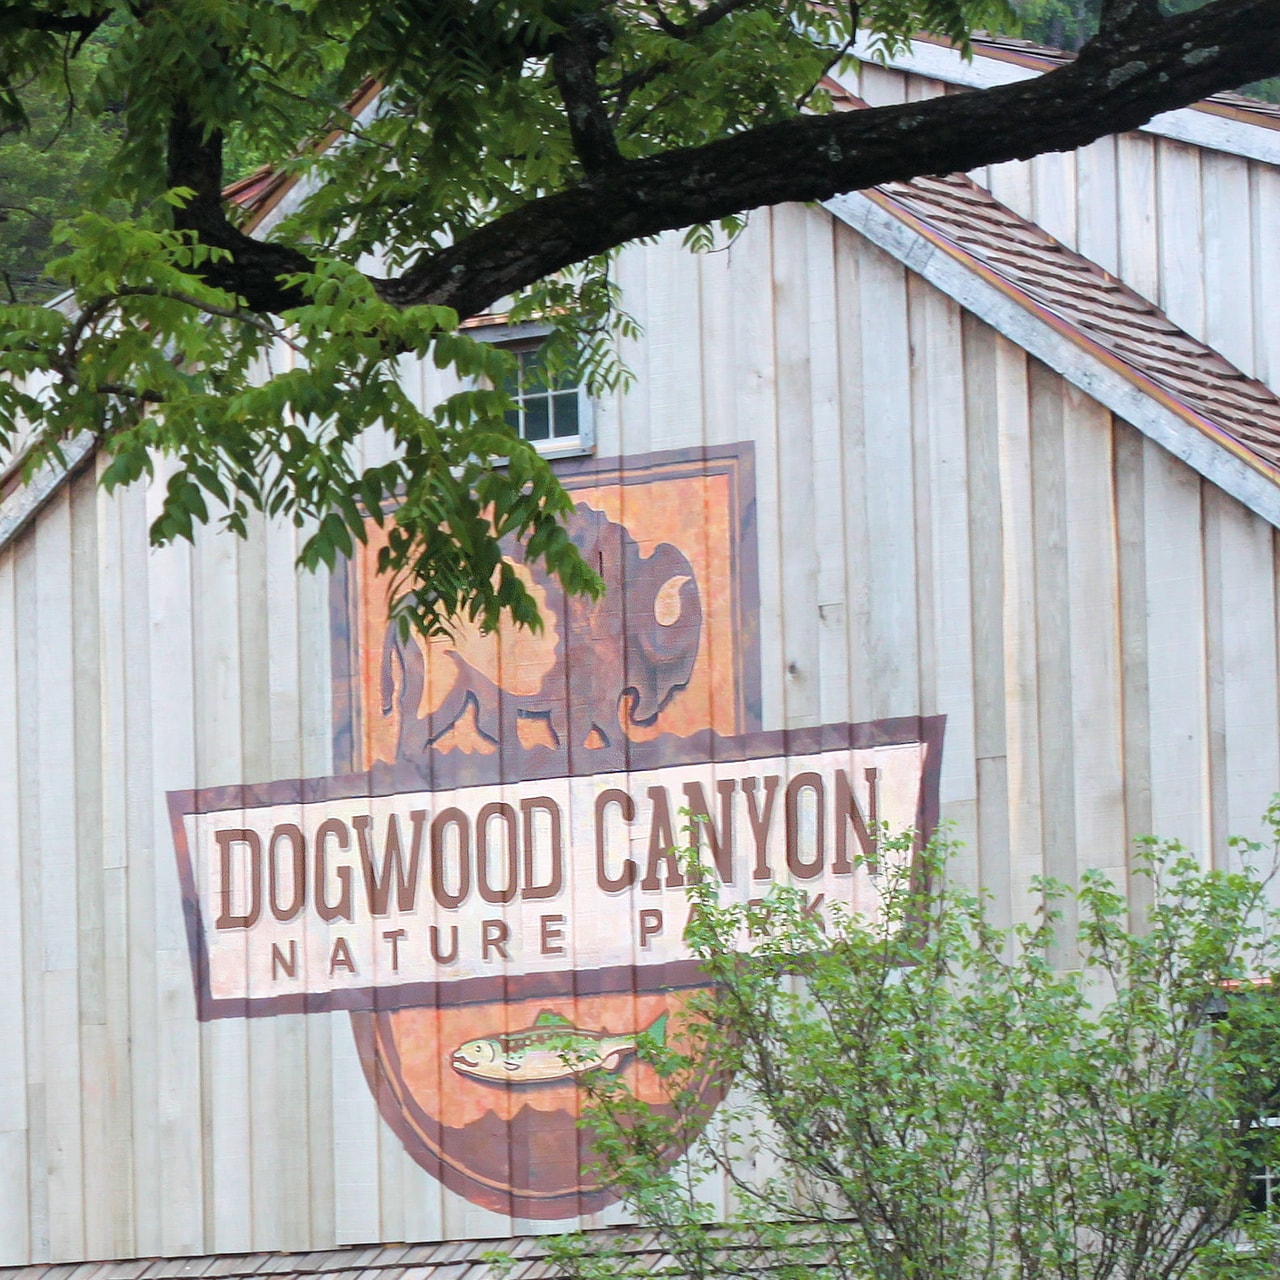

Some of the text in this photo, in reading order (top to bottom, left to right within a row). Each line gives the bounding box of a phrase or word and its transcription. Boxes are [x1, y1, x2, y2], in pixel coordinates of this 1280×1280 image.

[215, 767, 878, 929] DOGWOOD CANYON
[271, 914, 565, 981] NATURE
